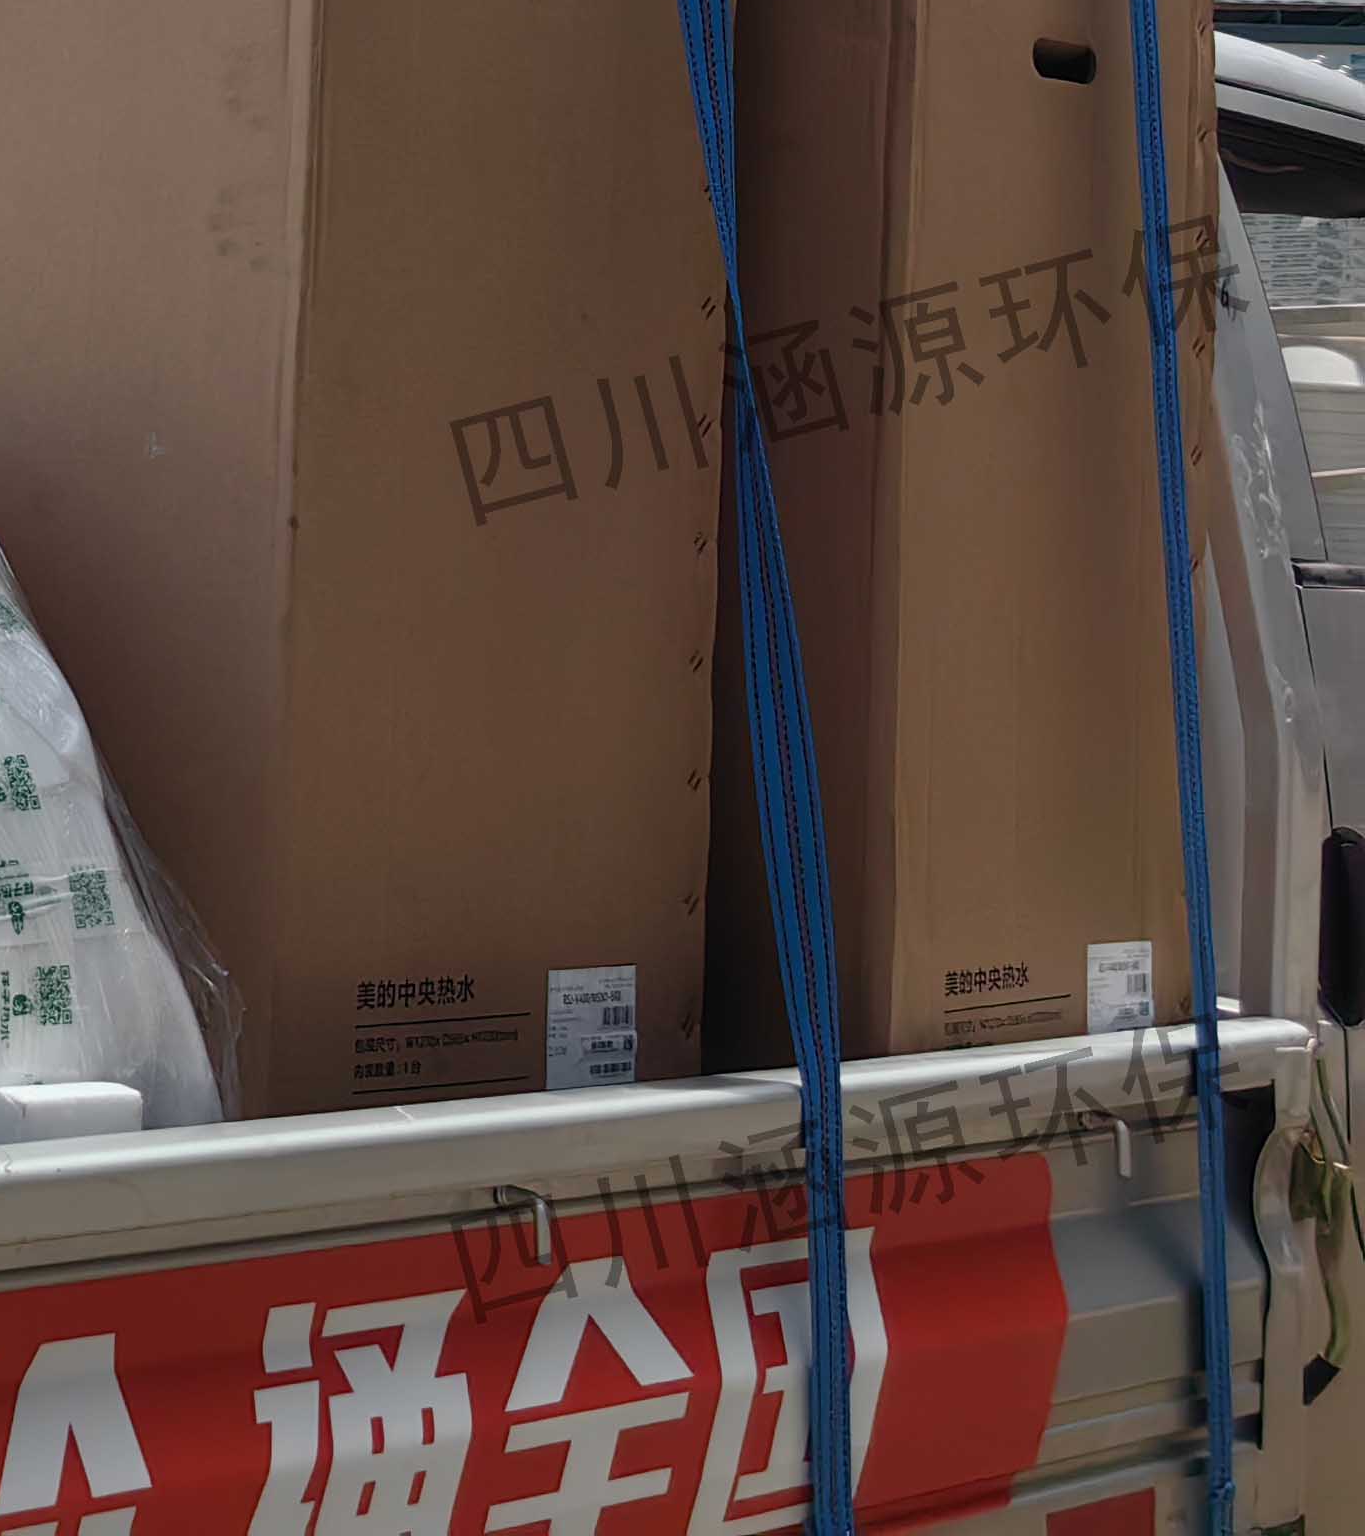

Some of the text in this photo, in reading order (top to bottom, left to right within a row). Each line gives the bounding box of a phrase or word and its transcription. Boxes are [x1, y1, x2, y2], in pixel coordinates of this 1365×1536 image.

[356, 973, 476, 1011] 美的中央热水
[944, 960, 1030, 997] 美的中央热水
[245, 1226, 889, 1536] 通全国
